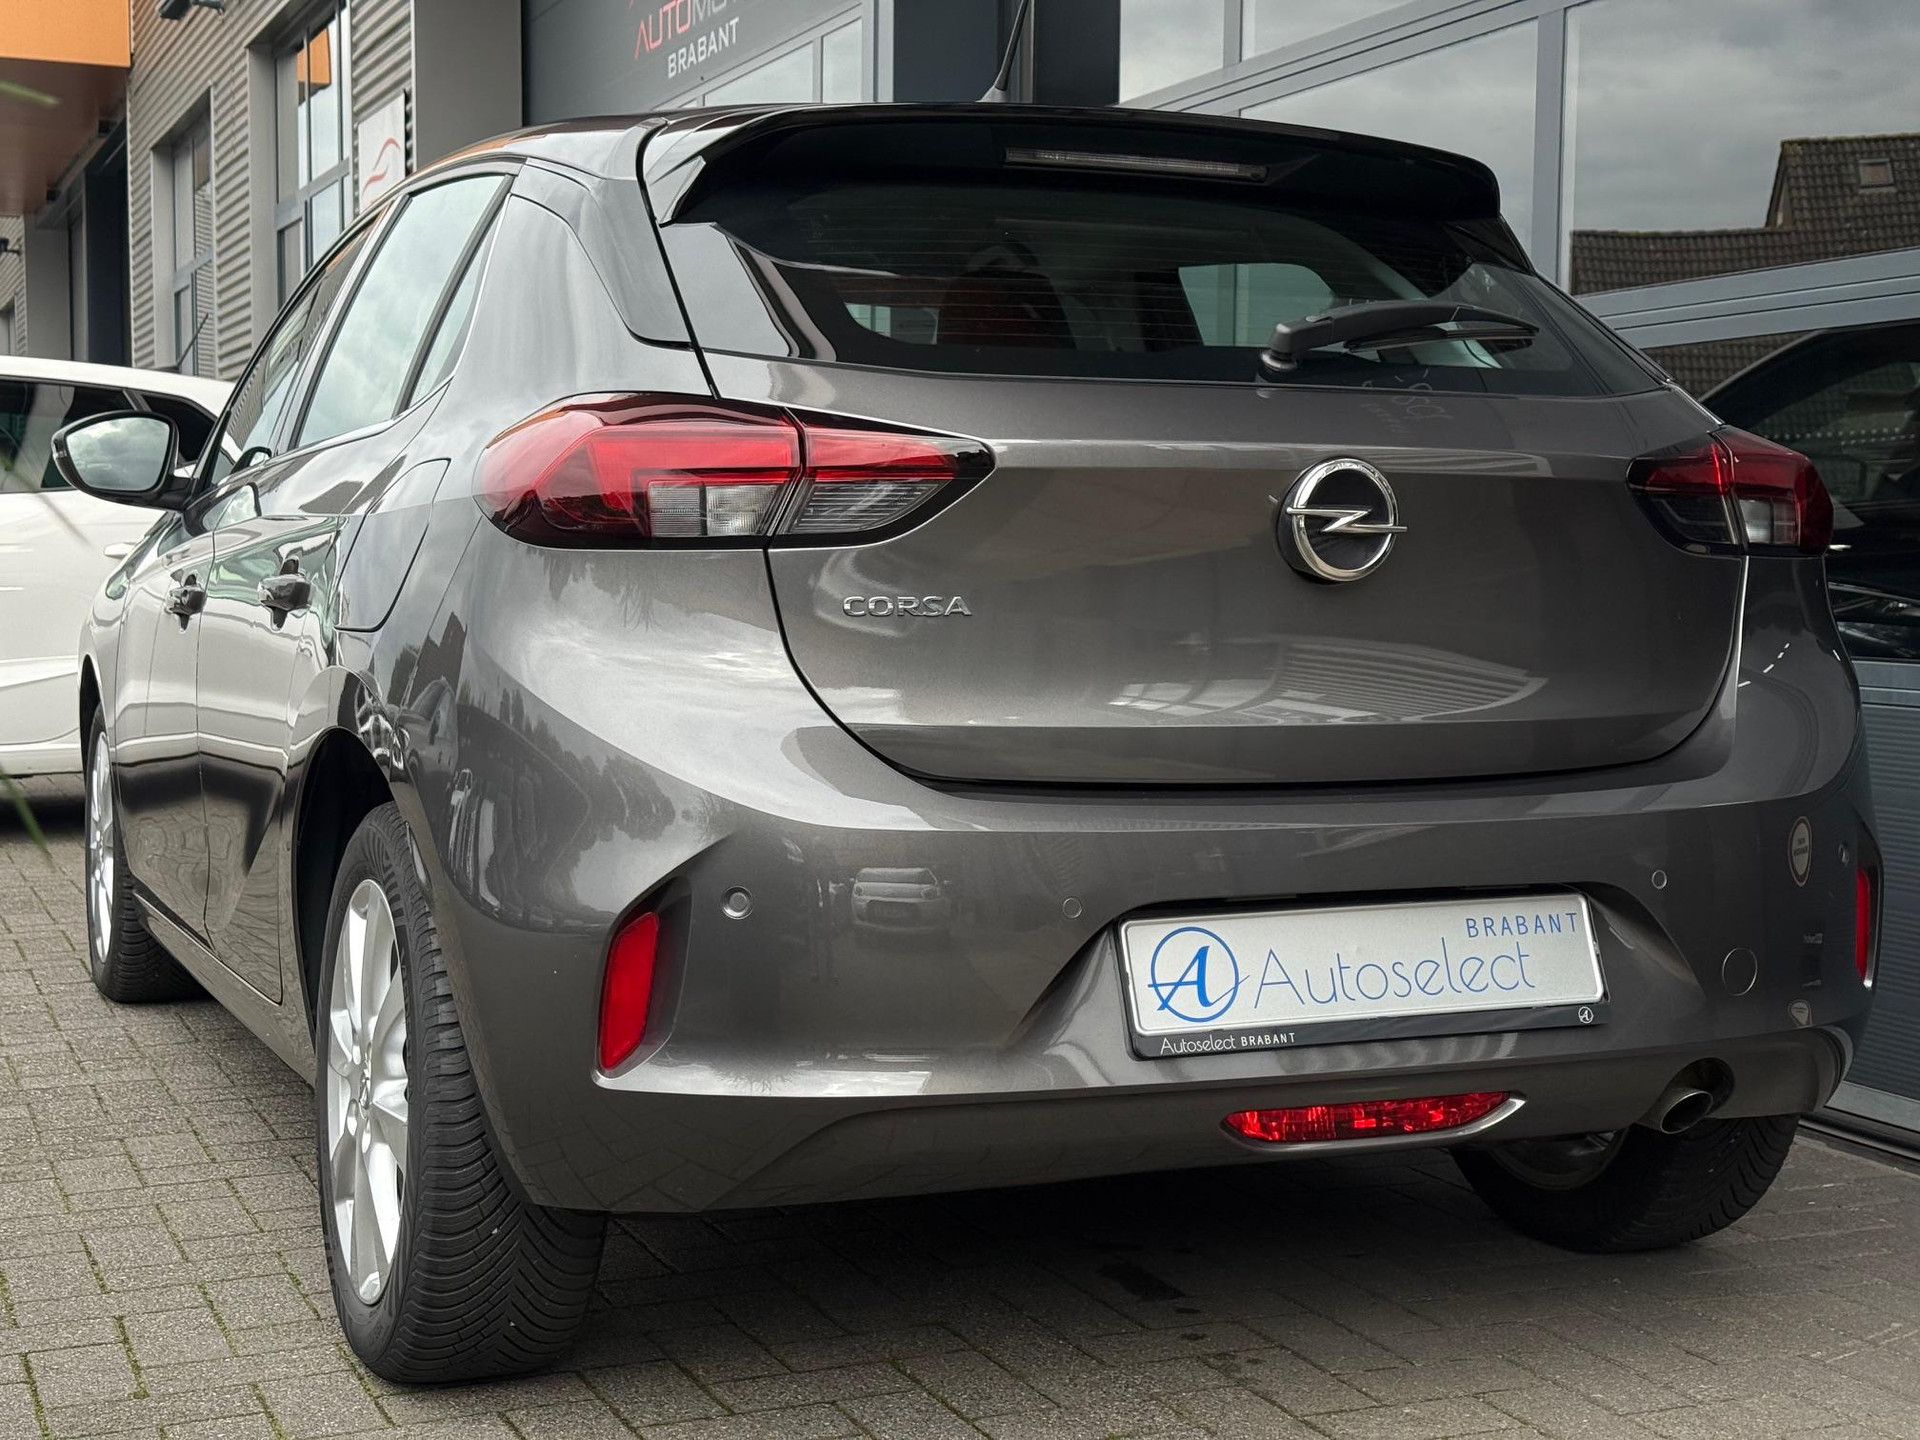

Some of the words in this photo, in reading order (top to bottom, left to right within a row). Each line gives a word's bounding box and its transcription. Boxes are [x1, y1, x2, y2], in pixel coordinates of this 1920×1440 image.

[667, 16, 739, 79] BRABANT
[843, 595, 973, 617] CORSA
[1466, 912, 1578, 938] BRABANT
[1254, 937, 1536, 1009] Autoselect
[1160, 1034, 1237, 1055] Autoselect
[1241, 1032, 1296, 1047] BRABANT
